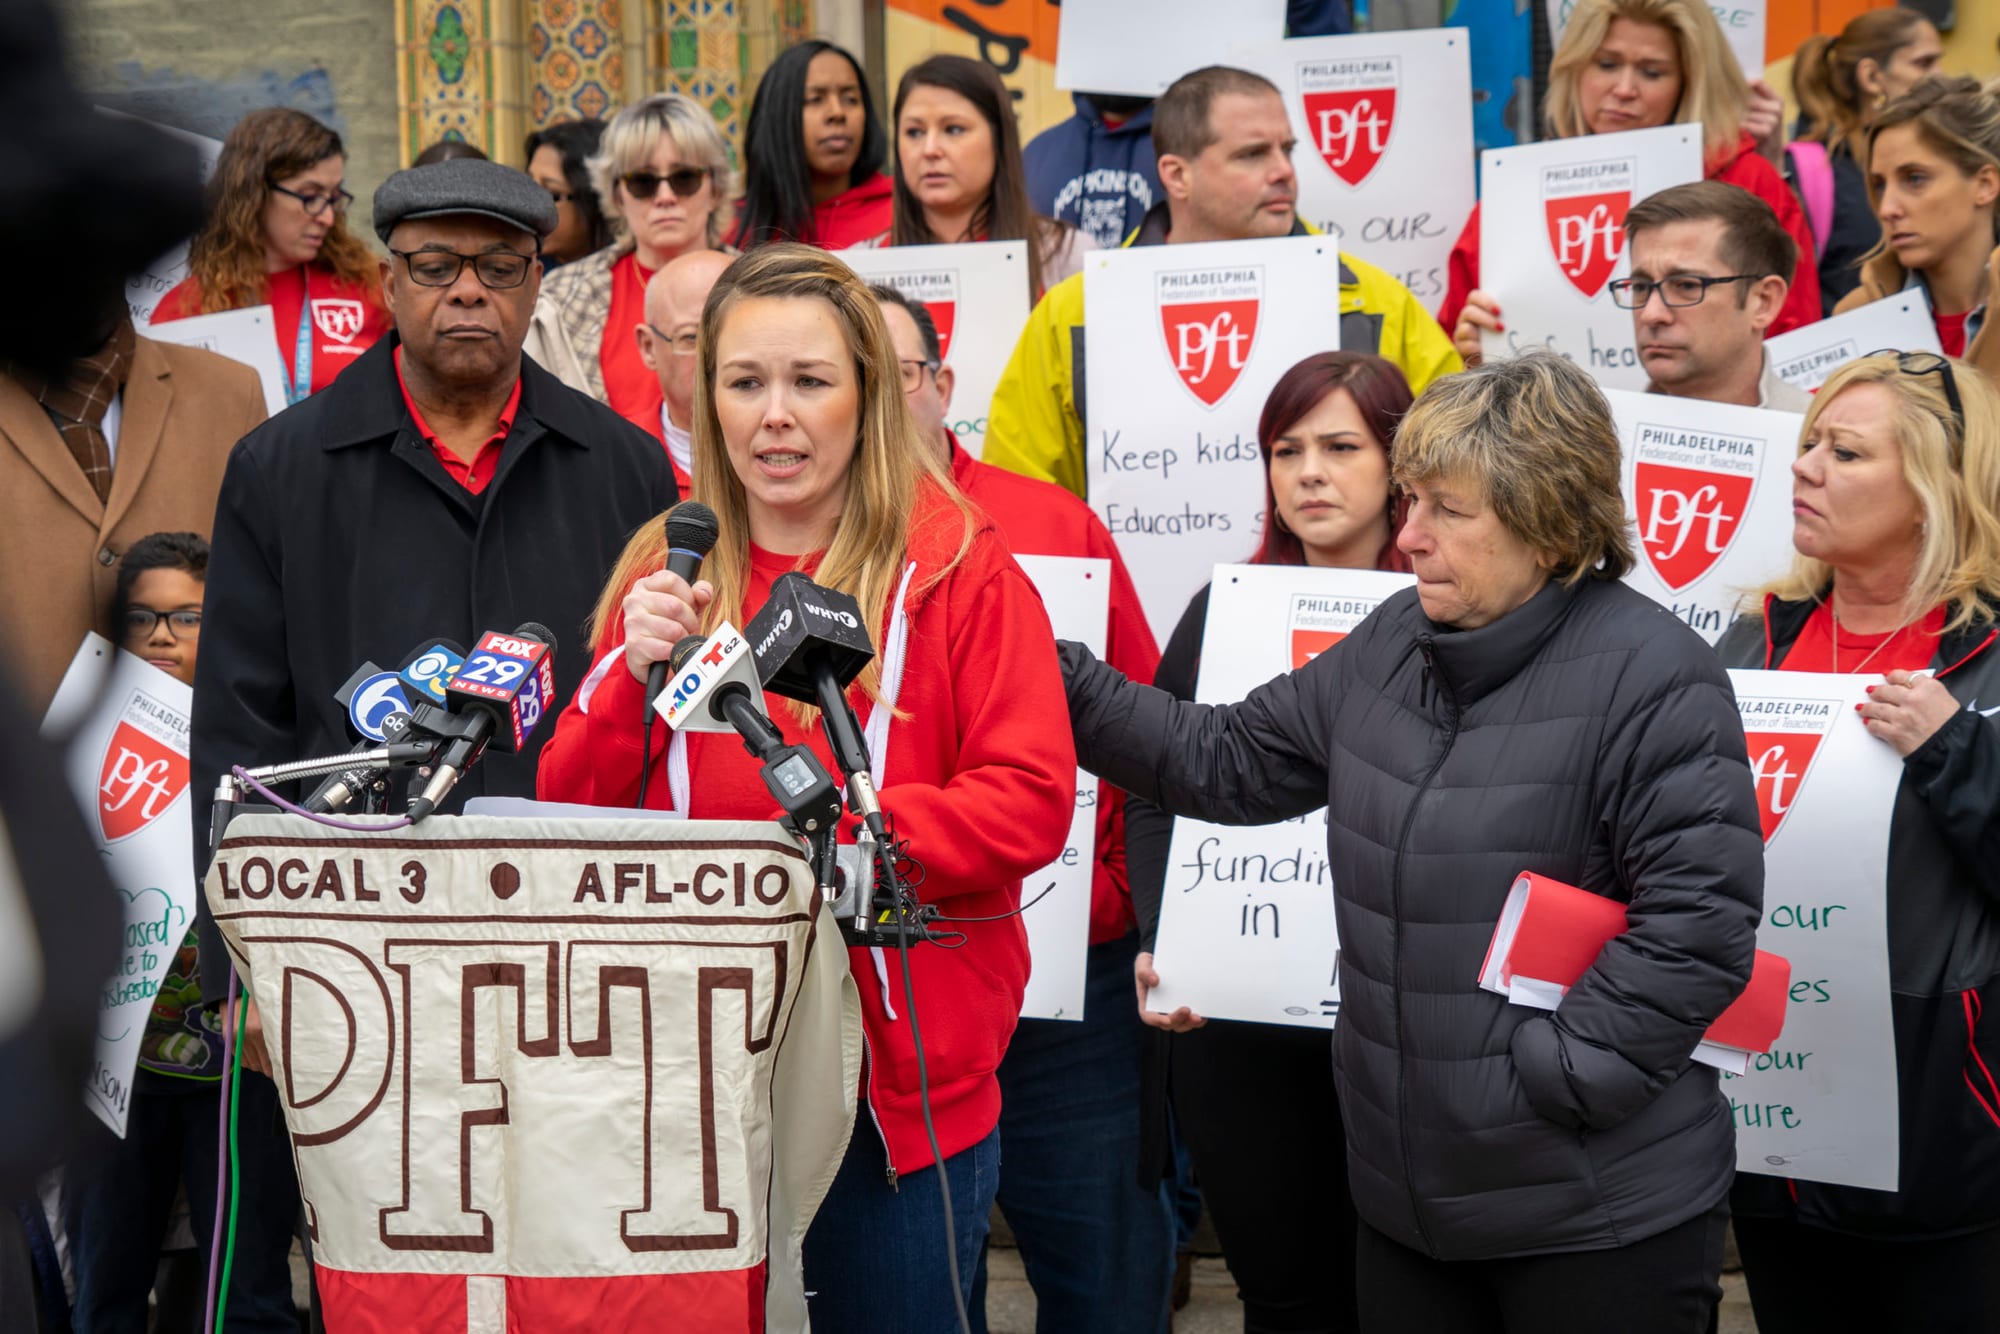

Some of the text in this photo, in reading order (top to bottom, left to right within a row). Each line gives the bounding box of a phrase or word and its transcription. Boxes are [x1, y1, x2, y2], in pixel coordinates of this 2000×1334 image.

[1302, 61, 1392, 76] PHILADELPHIA
[1316, 98, 1388, 168] pft
[1362, 212, 1448, 243] OUR
[1557, 203, 1626, 277] pft
[1161, 270, 1256, 287] PHILADELPHIA
[1395, 268, 1443, 296] ES
[1175, 311, 1248, 384] pft
[1587, 328, 1637, 368] hea
[1781, 347, 1849, 378] ADELPHIA
[1102, 429, 1258, 479] Keep kids
[1639, 445, 1690, 464] Federation
[1710, 454, 1753, 472] Teachers
[1642, 429, 1755, 457] PHILADELPHIA
[1106, 502, 1231, 535] Educators
[1642, 484, 1734, 561] pft
[486, 636, 537, 659] FOX
[462, 656, 524, 685] 29
[539, 658, 554, 706] FOX
[673, 673, 701, 703] 10
[723, 636, 741, 655] 62
[455, 681, 507, 697] NEWS
[519, 677, 540, 728] 29
[511, 700, 523, 747] NEWS
[100, 746, 171, 820] pft
[1748, 745, 1797, 814] ft
[217, 858, 791, 907] LOCAL 3 AFL-CIO
[126, 907, 170, 948] osed
[1241, 893, 1280, 939] in
[1771, 904, 1847, 931] our
[140, 949, 158, 972] to
[1789, 979, 1831, 1003] es
[1755, 1050, 1813, 1071] our
[238, 935, 788, 1253] PFT
[1731, 1097, 1801, 1129] ture
